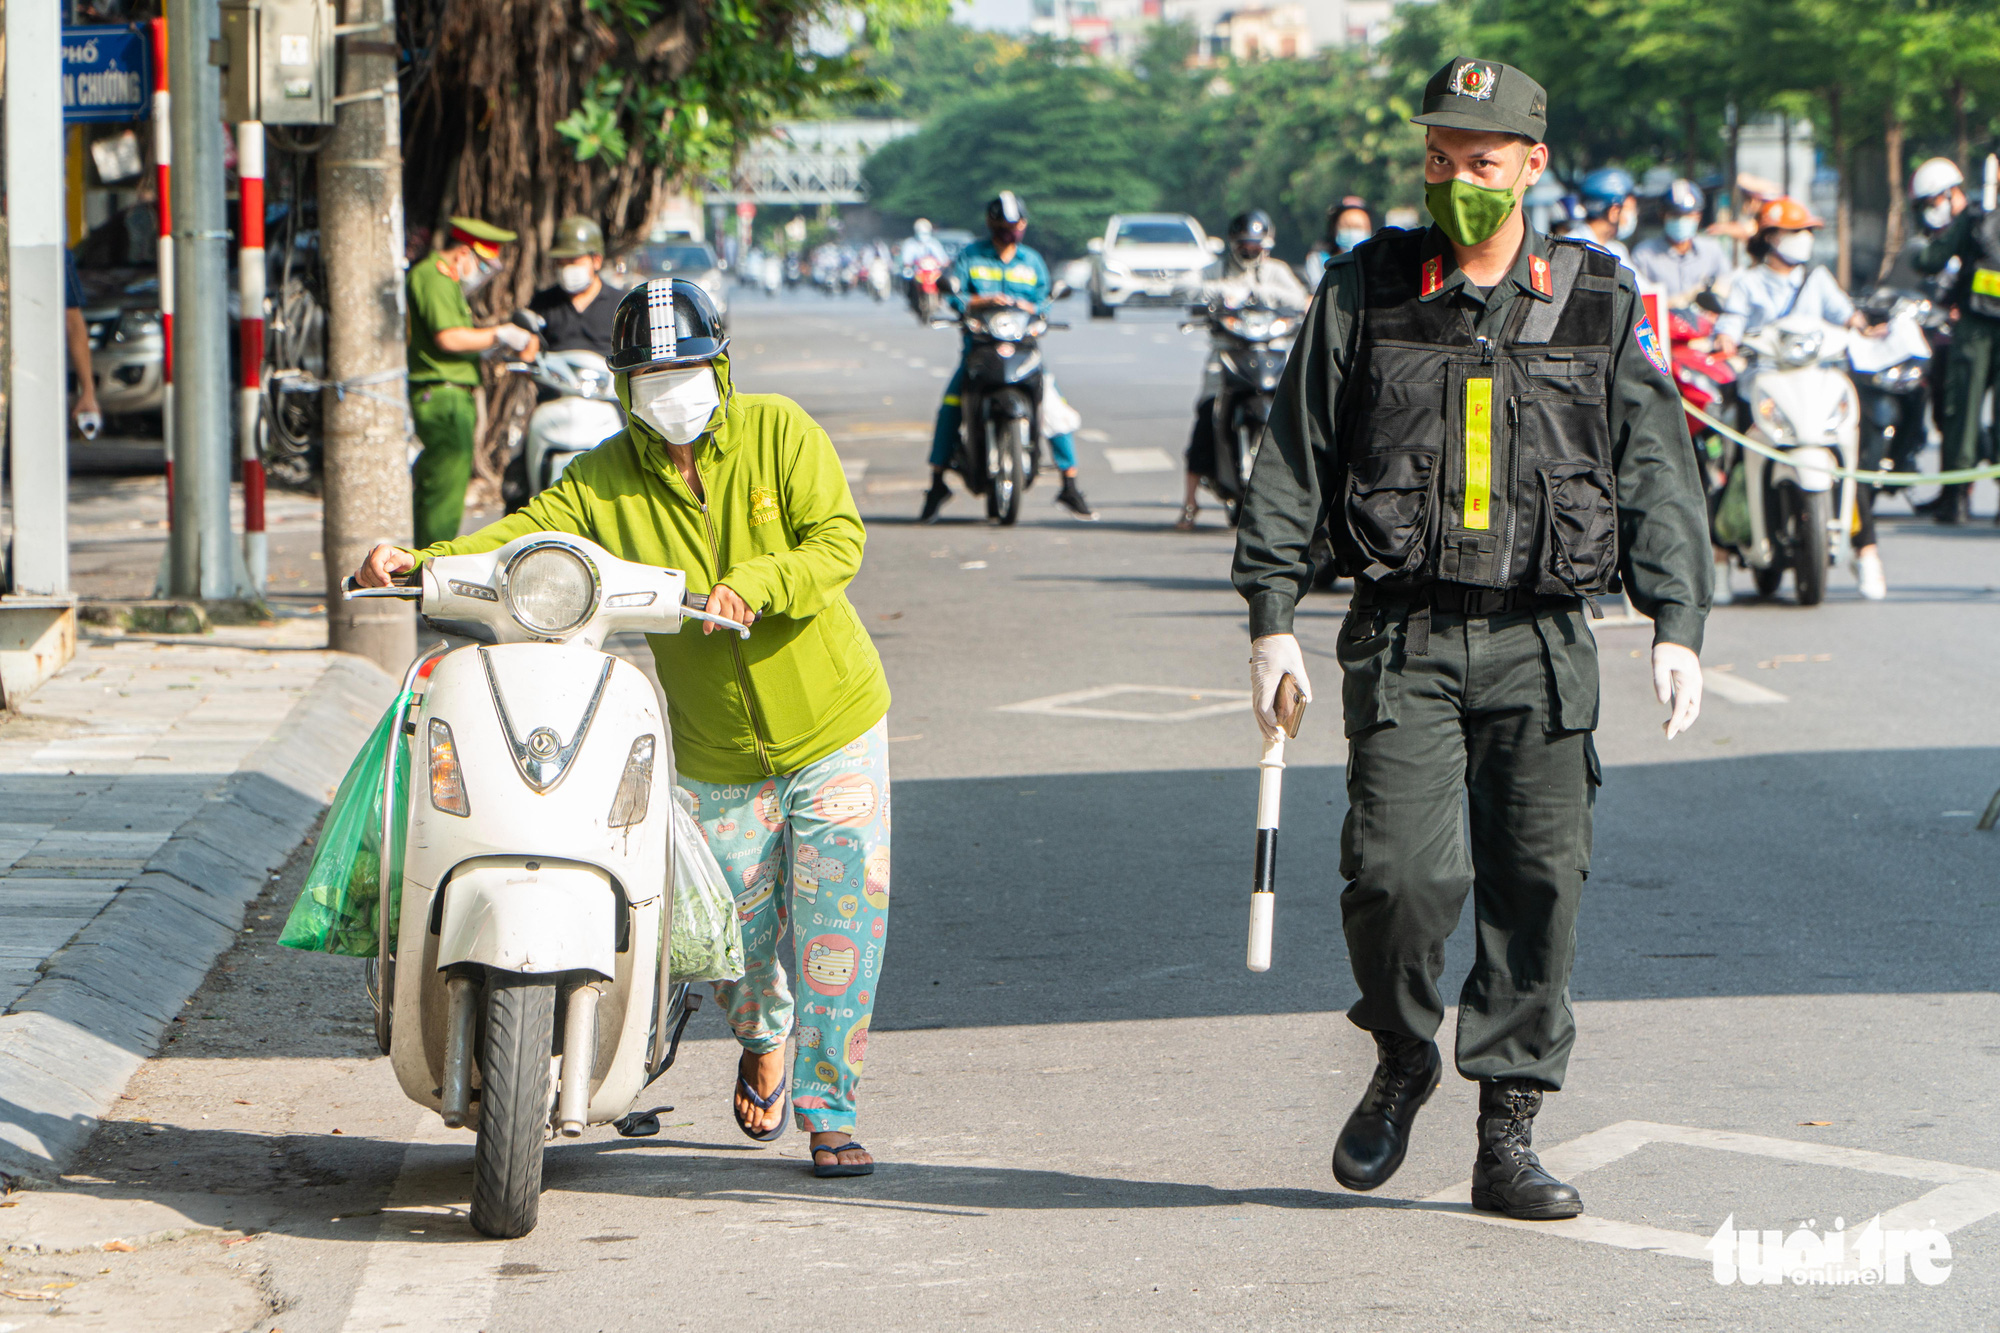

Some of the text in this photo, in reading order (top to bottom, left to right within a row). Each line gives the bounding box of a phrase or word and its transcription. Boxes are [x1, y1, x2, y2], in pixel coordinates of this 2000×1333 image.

[812, 913, 863, 933] Sunday
[861, 941, 878, 978] oday
[792, 1078, 844, 1099] Sunday
